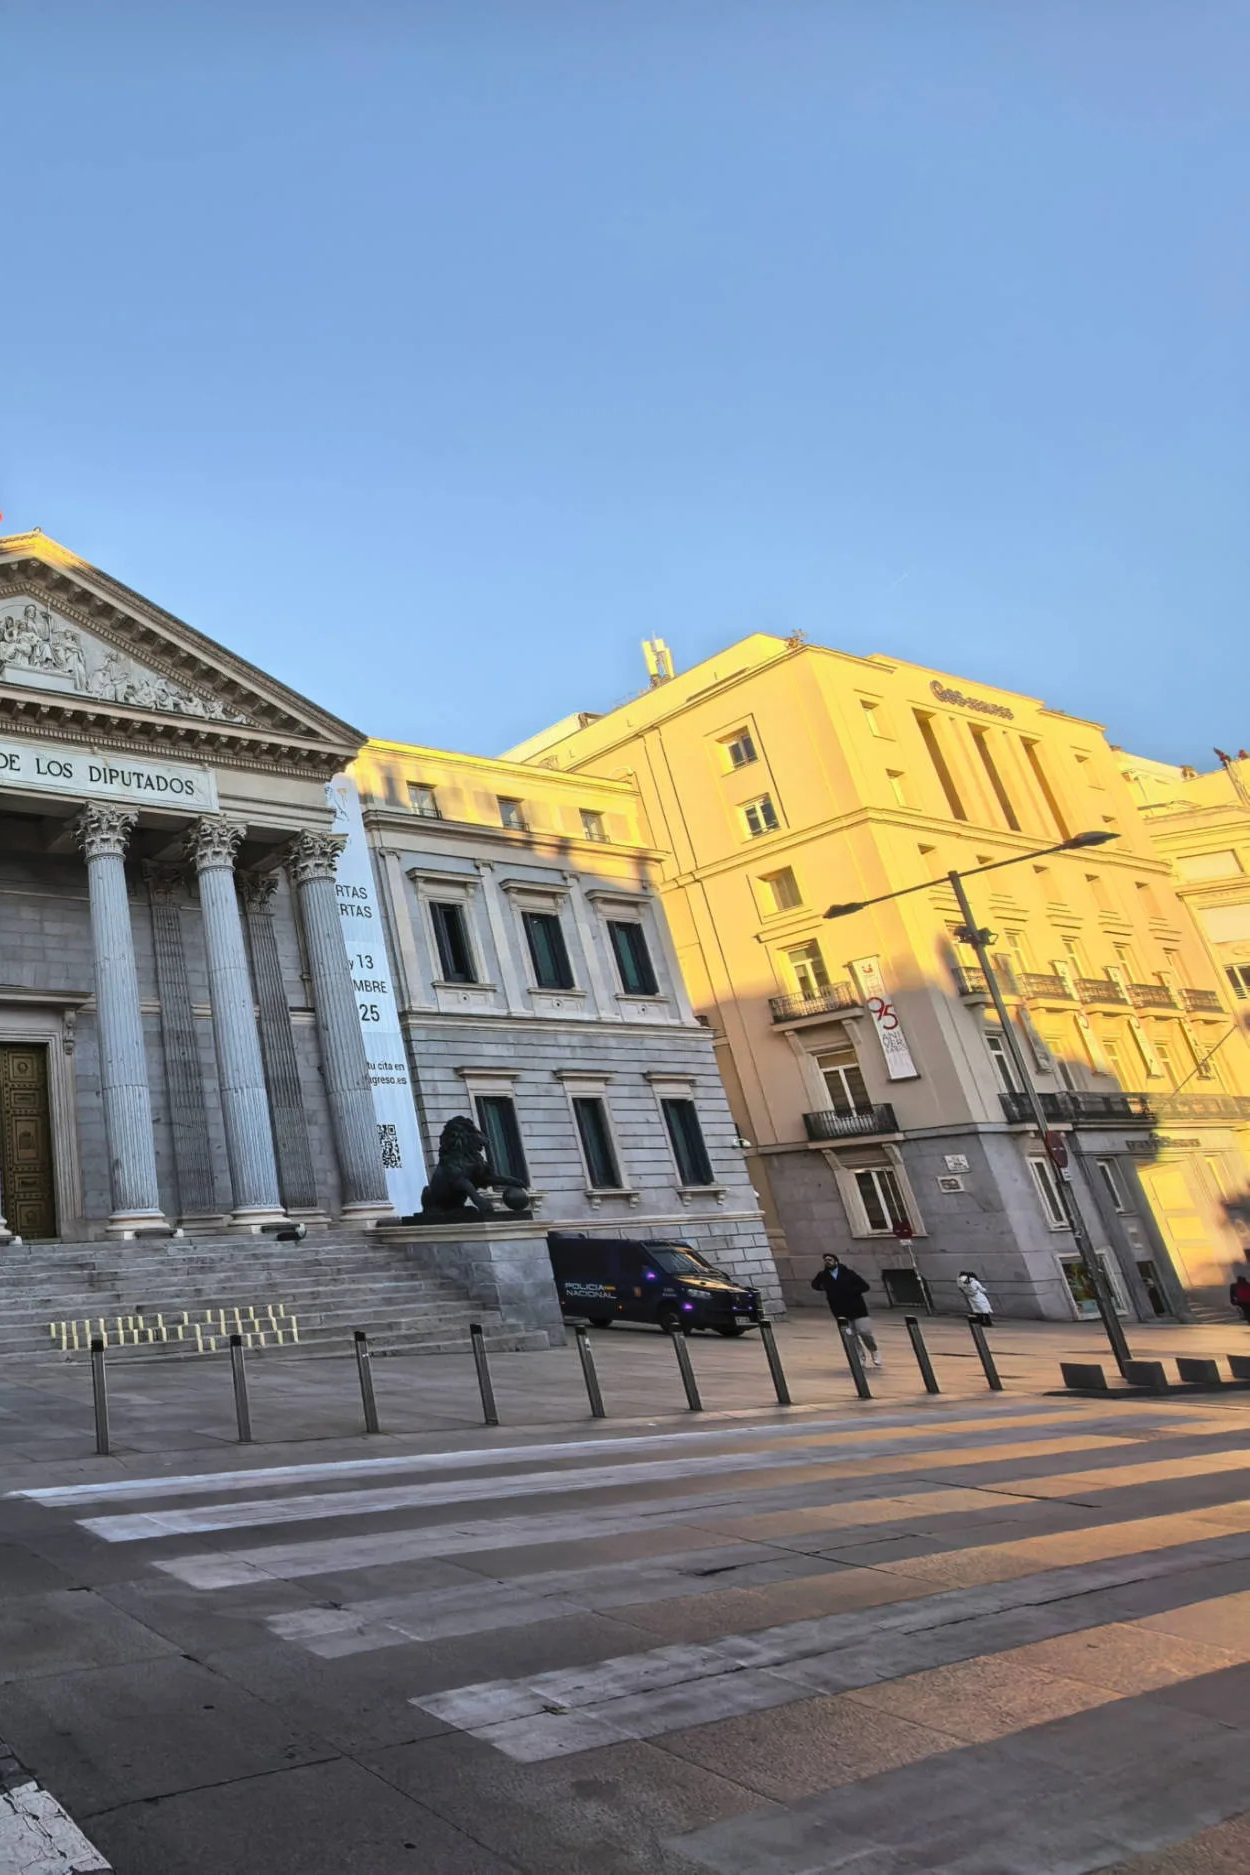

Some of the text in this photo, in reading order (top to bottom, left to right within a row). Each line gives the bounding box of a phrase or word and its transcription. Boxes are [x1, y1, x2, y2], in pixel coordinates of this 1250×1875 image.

[36, 758, 73, 779] LOS
[89, 765, 194, 796] DIPUTADOS
[336, 884, 368, 899] RTAS
[340, 903, 373, 919] RTAS
[356, 954, 374, 969] 13
[359, 1003, 380, 1022] 25
[867, 997, 899, 1030] 95
